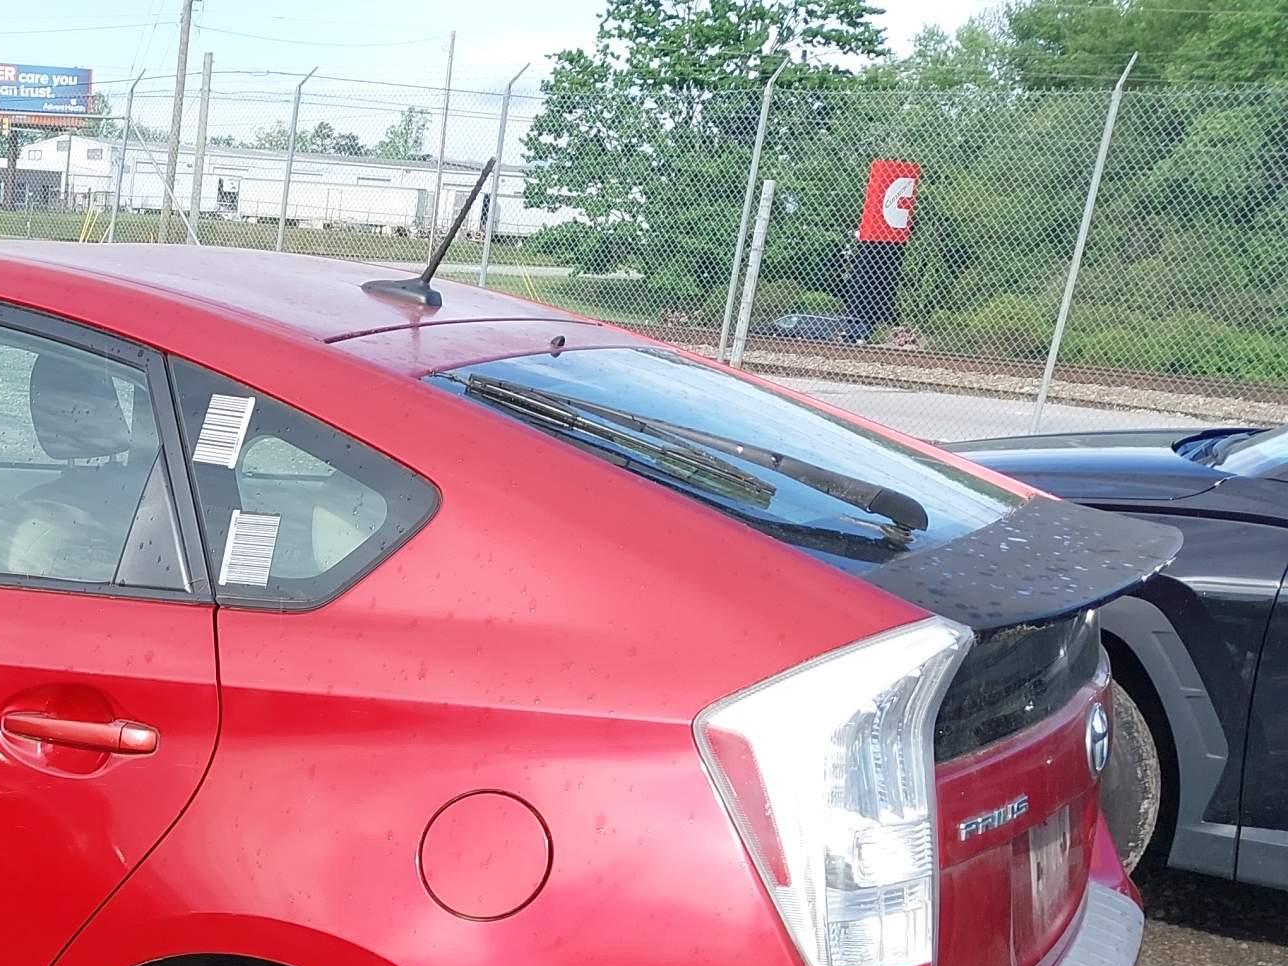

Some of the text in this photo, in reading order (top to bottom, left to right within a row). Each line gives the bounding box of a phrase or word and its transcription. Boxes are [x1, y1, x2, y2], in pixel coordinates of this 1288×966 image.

[18, 72, 49, 84] care
[52, 74, 78, 87] you
[19, 85, 56, 99] trust.
[959, 794, 1029, 841] PRIUS
